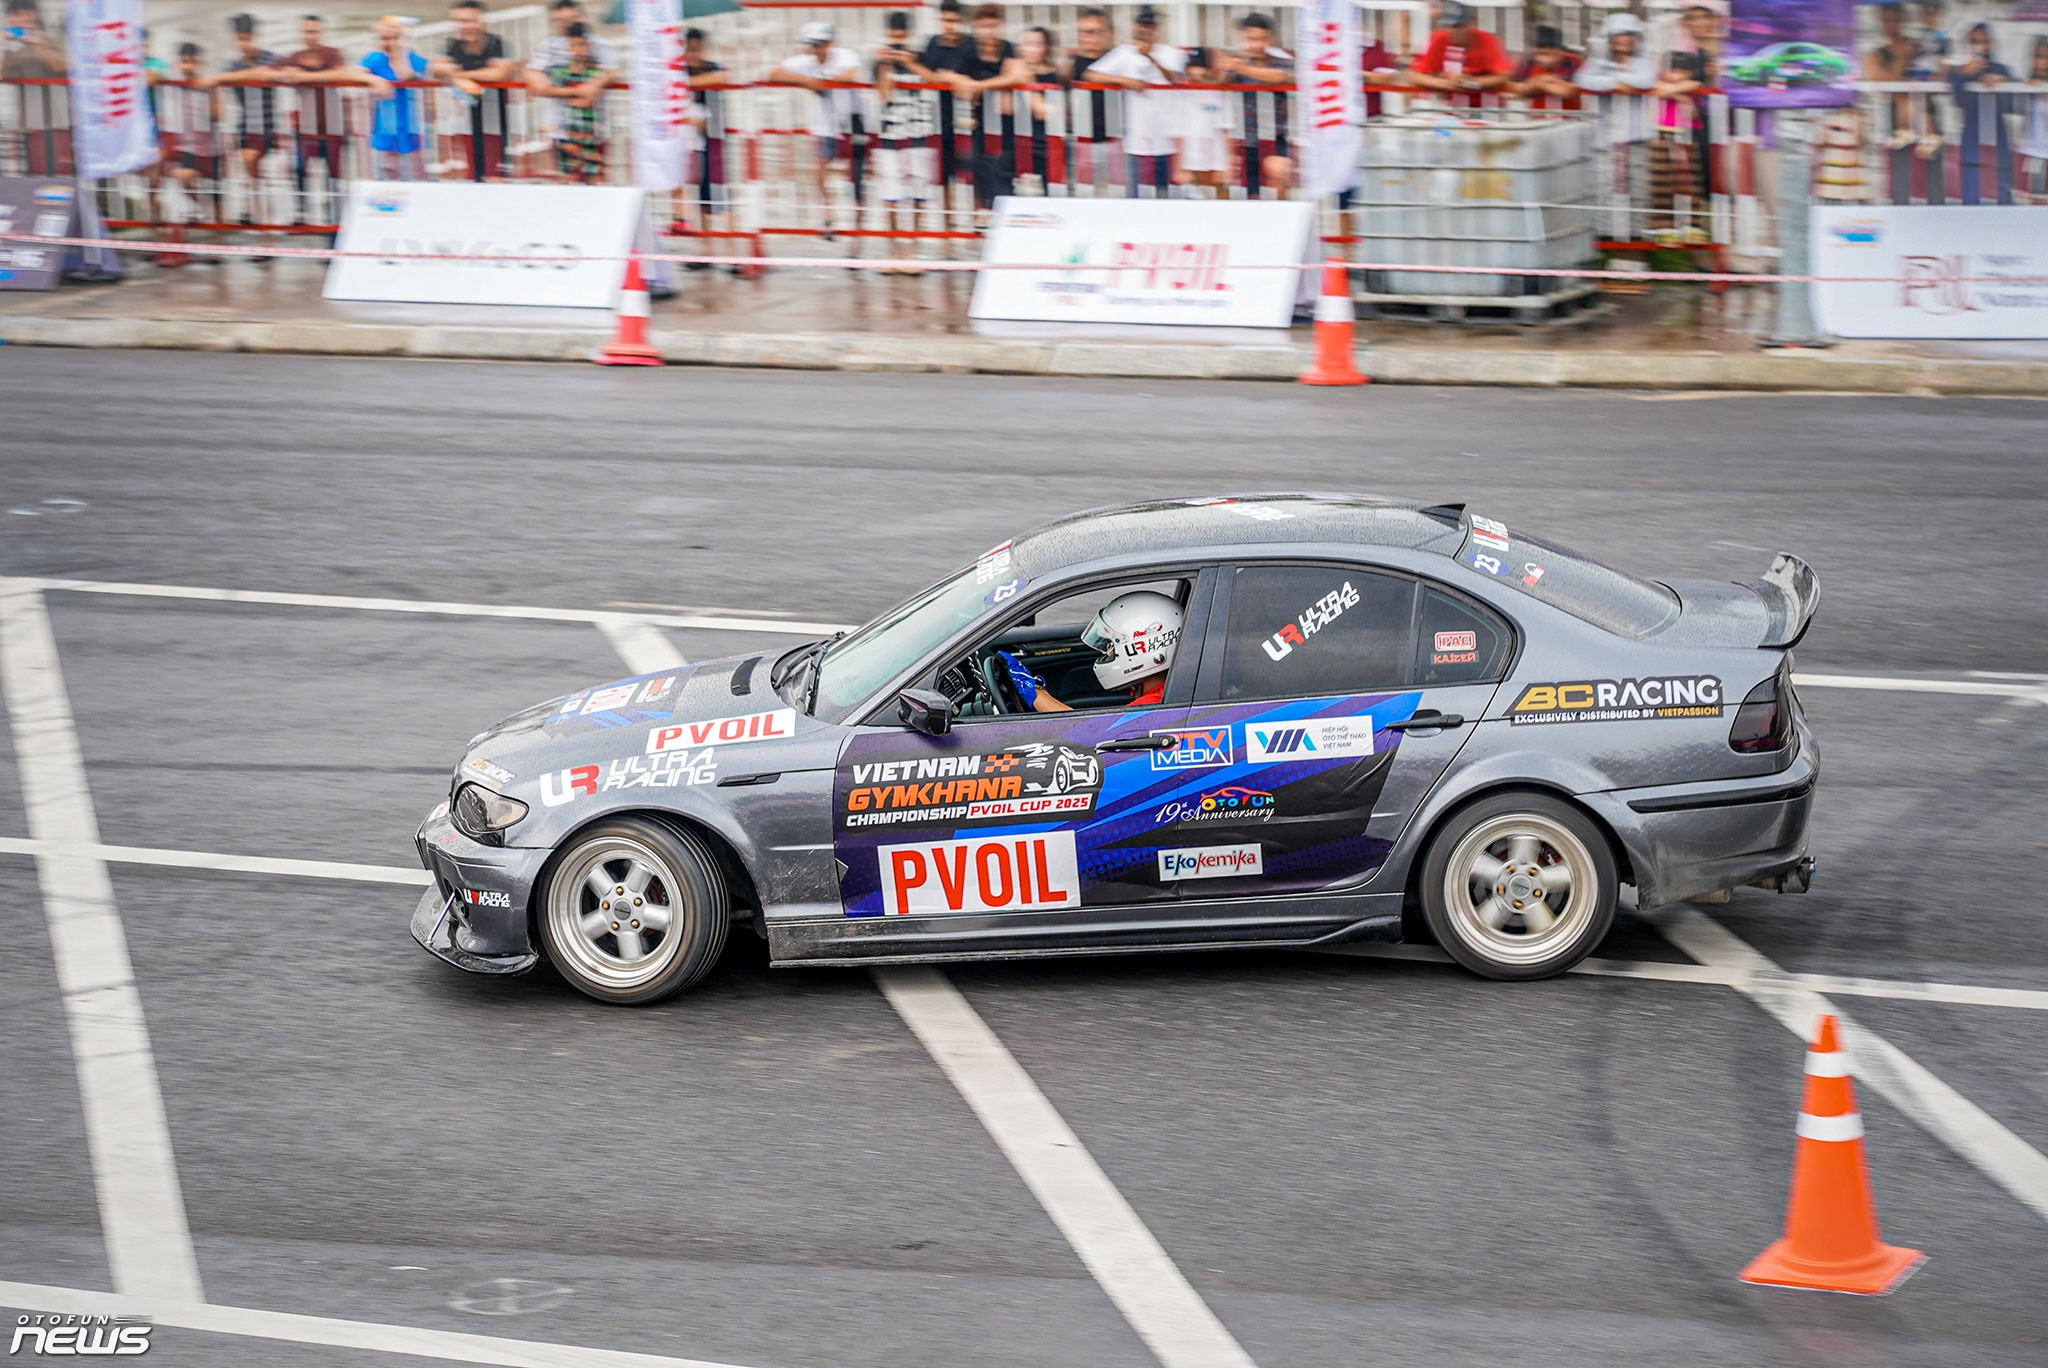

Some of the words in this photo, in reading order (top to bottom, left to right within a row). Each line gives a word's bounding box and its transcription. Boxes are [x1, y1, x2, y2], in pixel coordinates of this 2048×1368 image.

[1474, 554, 1501, 575] 23
[994, 579, 1018, 602] 23
[1299, 581, 1353, 627] ULTRA
[1302, 588, 1360, 639] RACING
[1125, 641, 1147, 657] UR
[1262, 623, 1305, 661] UR
[1441, 635, 1470, 646] PAC
[1513, 684, 1595, 711] BC
[1597, 678, 1719, 707] RACING
[1514, 712, 1578, 723] EXCLUSIVELY
[1580, 708, 1640, 720] DISTRIBUTED
[1642, 708, 1655, 718] BY
[1657, 706, 1719, 717] VIETPASSION
[656, 713, 784, 749] PVOIL
[609, 748, 715, 776] ULTRA
[853, 755, 981, 784] VIETNAM
[1157, 747, 1230, 765] MEDIA
[539, 765, 600, 807] UR
[602, 763, 718, 792] RACING
[848, 776, 1022, 811] GYMKHANA
[846, 806, 968, 827] CHAMPIONSHIP
[970, 804, 1015, 816] PVOIL
[1020, 800, 1052, 811] CUP
[1056, 797, 1089, 809] 2025
[1181, 805, 1274, 822] Anniversary
[891, 839, 1067, 914] PVOIL
[1165, 850, 1256, 875] Ekokemika
[478, 899, 511, 908] RACING
[479, 891, 510, 901] ULTRA
